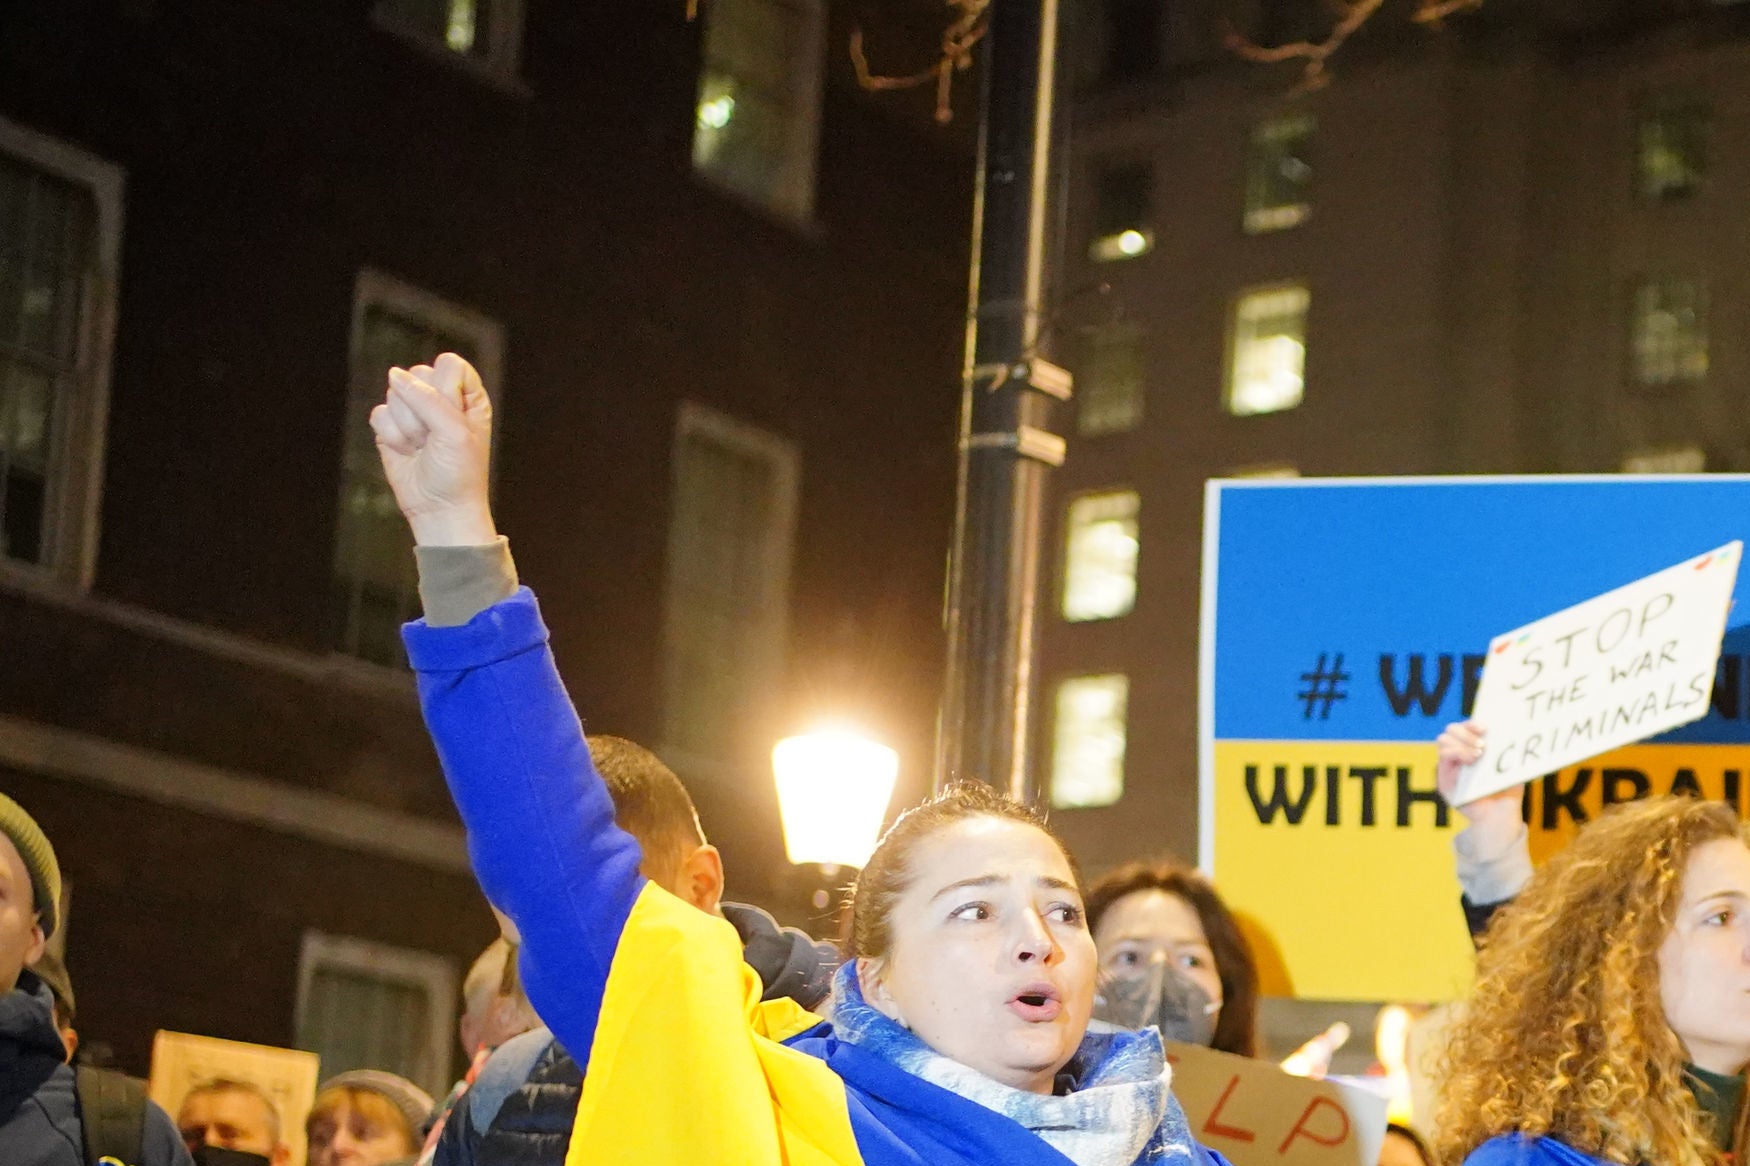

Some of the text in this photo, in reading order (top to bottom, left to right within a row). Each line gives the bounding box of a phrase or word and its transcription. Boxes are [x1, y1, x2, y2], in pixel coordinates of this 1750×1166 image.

[1511, 593, 1674, 690] STOP
[1525, 640, 1678, 720] THE WAR
[1495, 672, 1706, 774] CRIMINALS
[1245, 765, 1450, 828] WITH
[1167, 1054, 1350, 1155] LP
